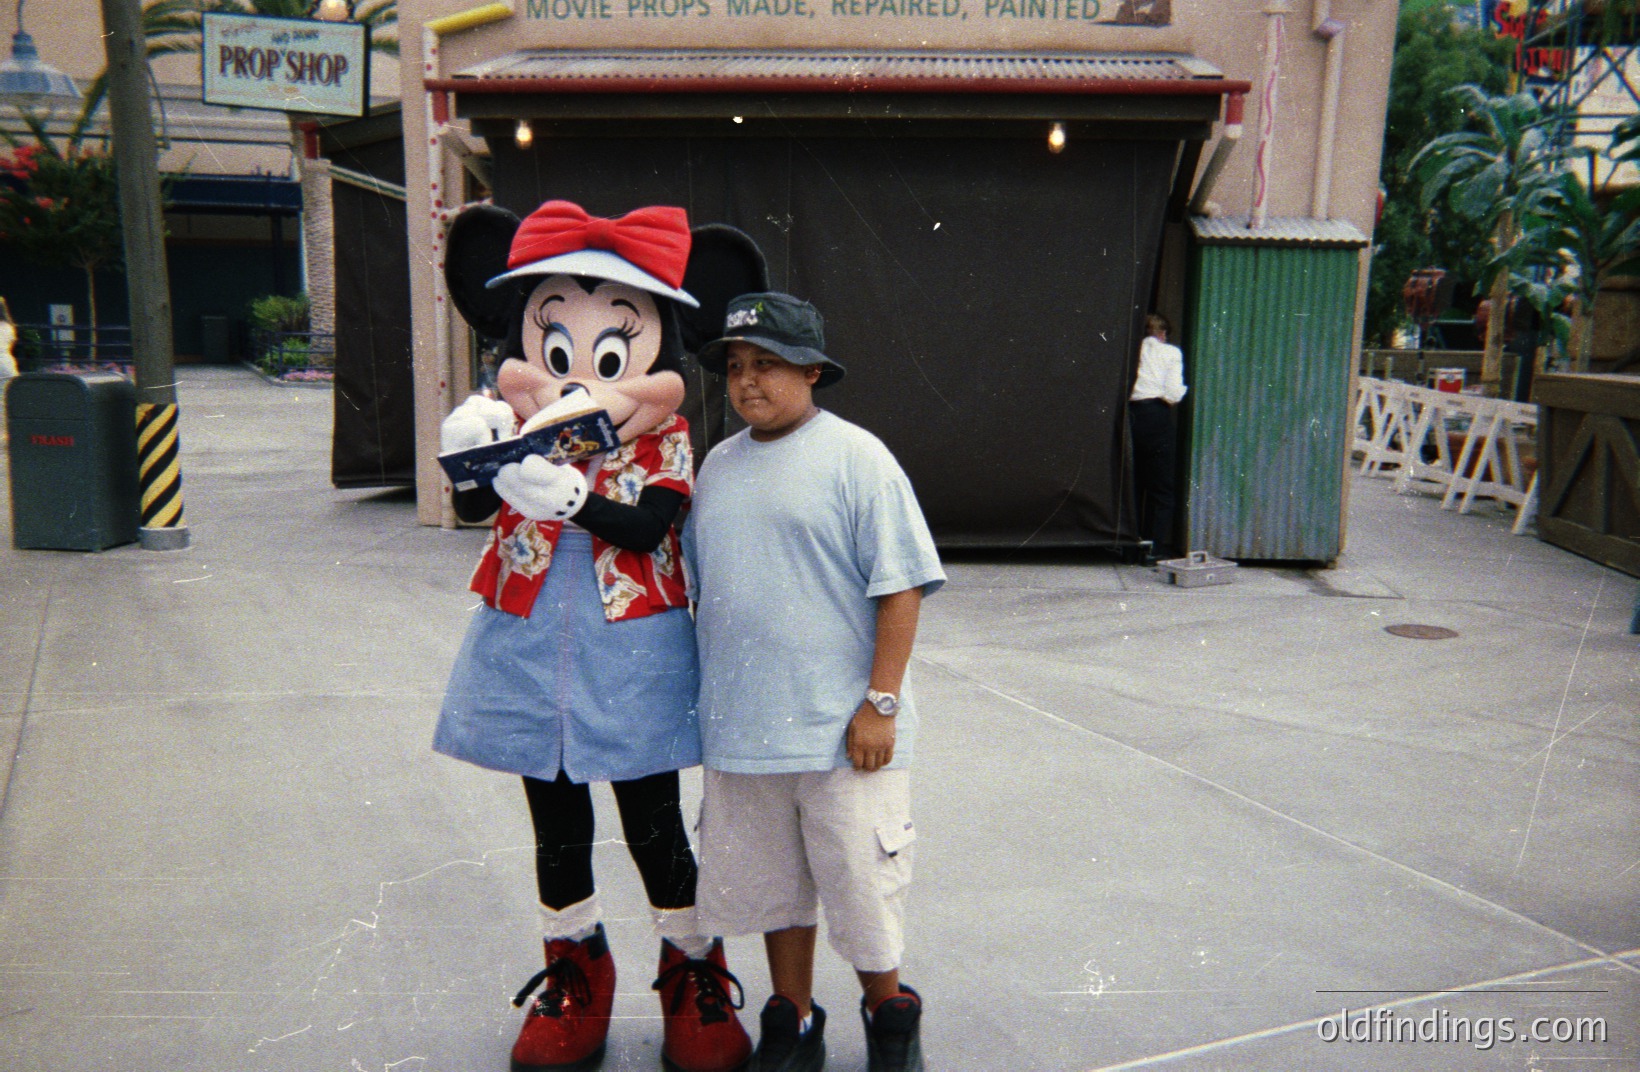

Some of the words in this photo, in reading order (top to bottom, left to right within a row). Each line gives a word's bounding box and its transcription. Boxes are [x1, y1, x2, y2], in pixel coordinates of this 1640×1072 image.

[526, 0, 612, 19] MOVIE
[628, 0, 711, 18] PROPS
[727, 0, 815, 18] MADE,
[832, 0, 968, 20] REPAIRED,
[984, 0, 1101, 20] PAINTED
[219, 44, 281, 82] PROP
[285, 50, 349, 87] SHOP
